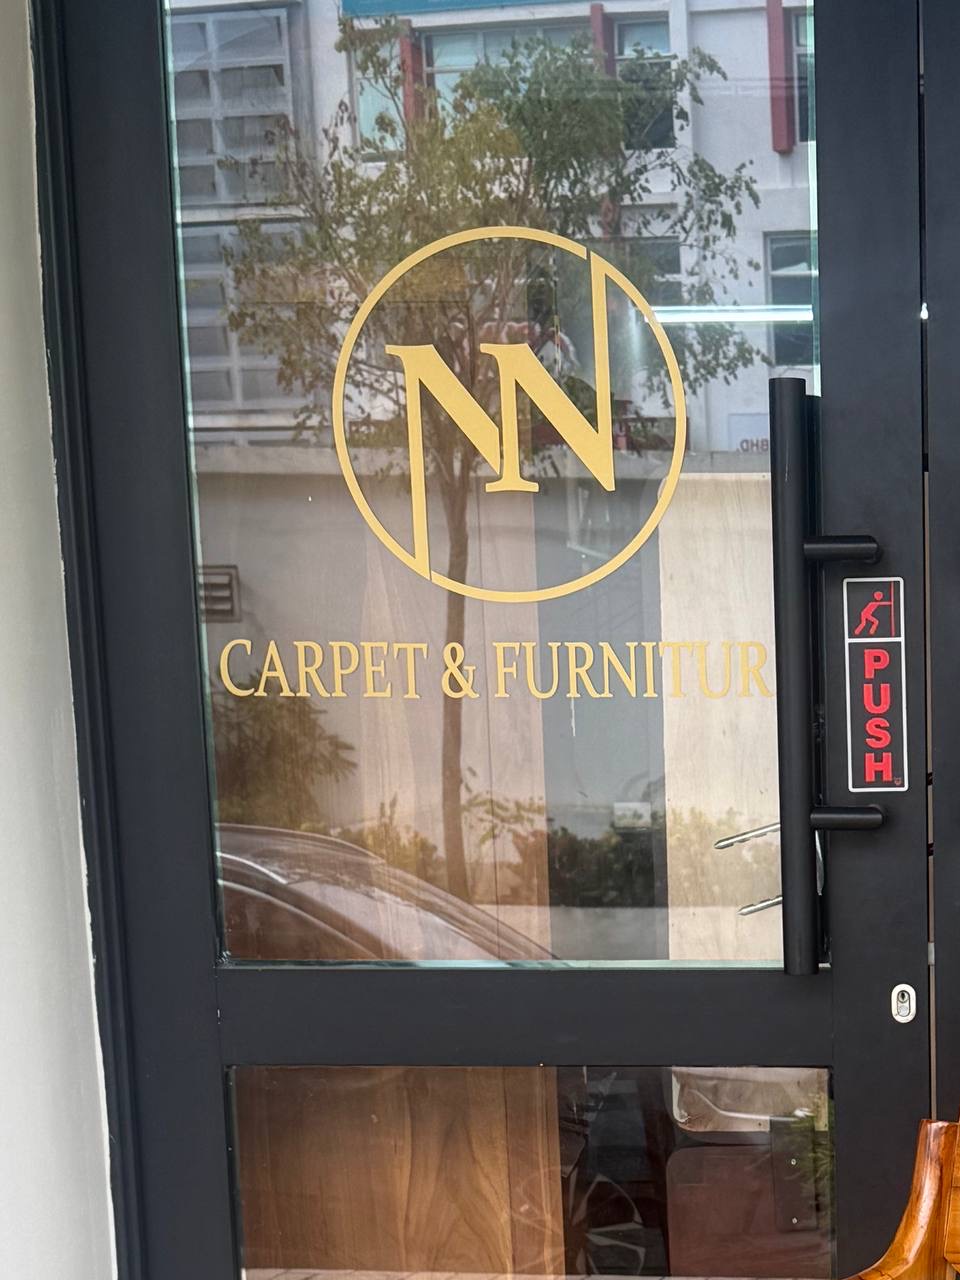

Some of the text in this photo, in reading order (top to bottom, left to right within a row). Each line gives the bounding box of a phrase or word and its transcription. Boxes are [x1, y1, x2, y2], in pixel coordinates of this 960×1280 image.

[219, 639, 775, 699] CARPET & FURNITUR
[863, 648, 893, 783] PUSH
